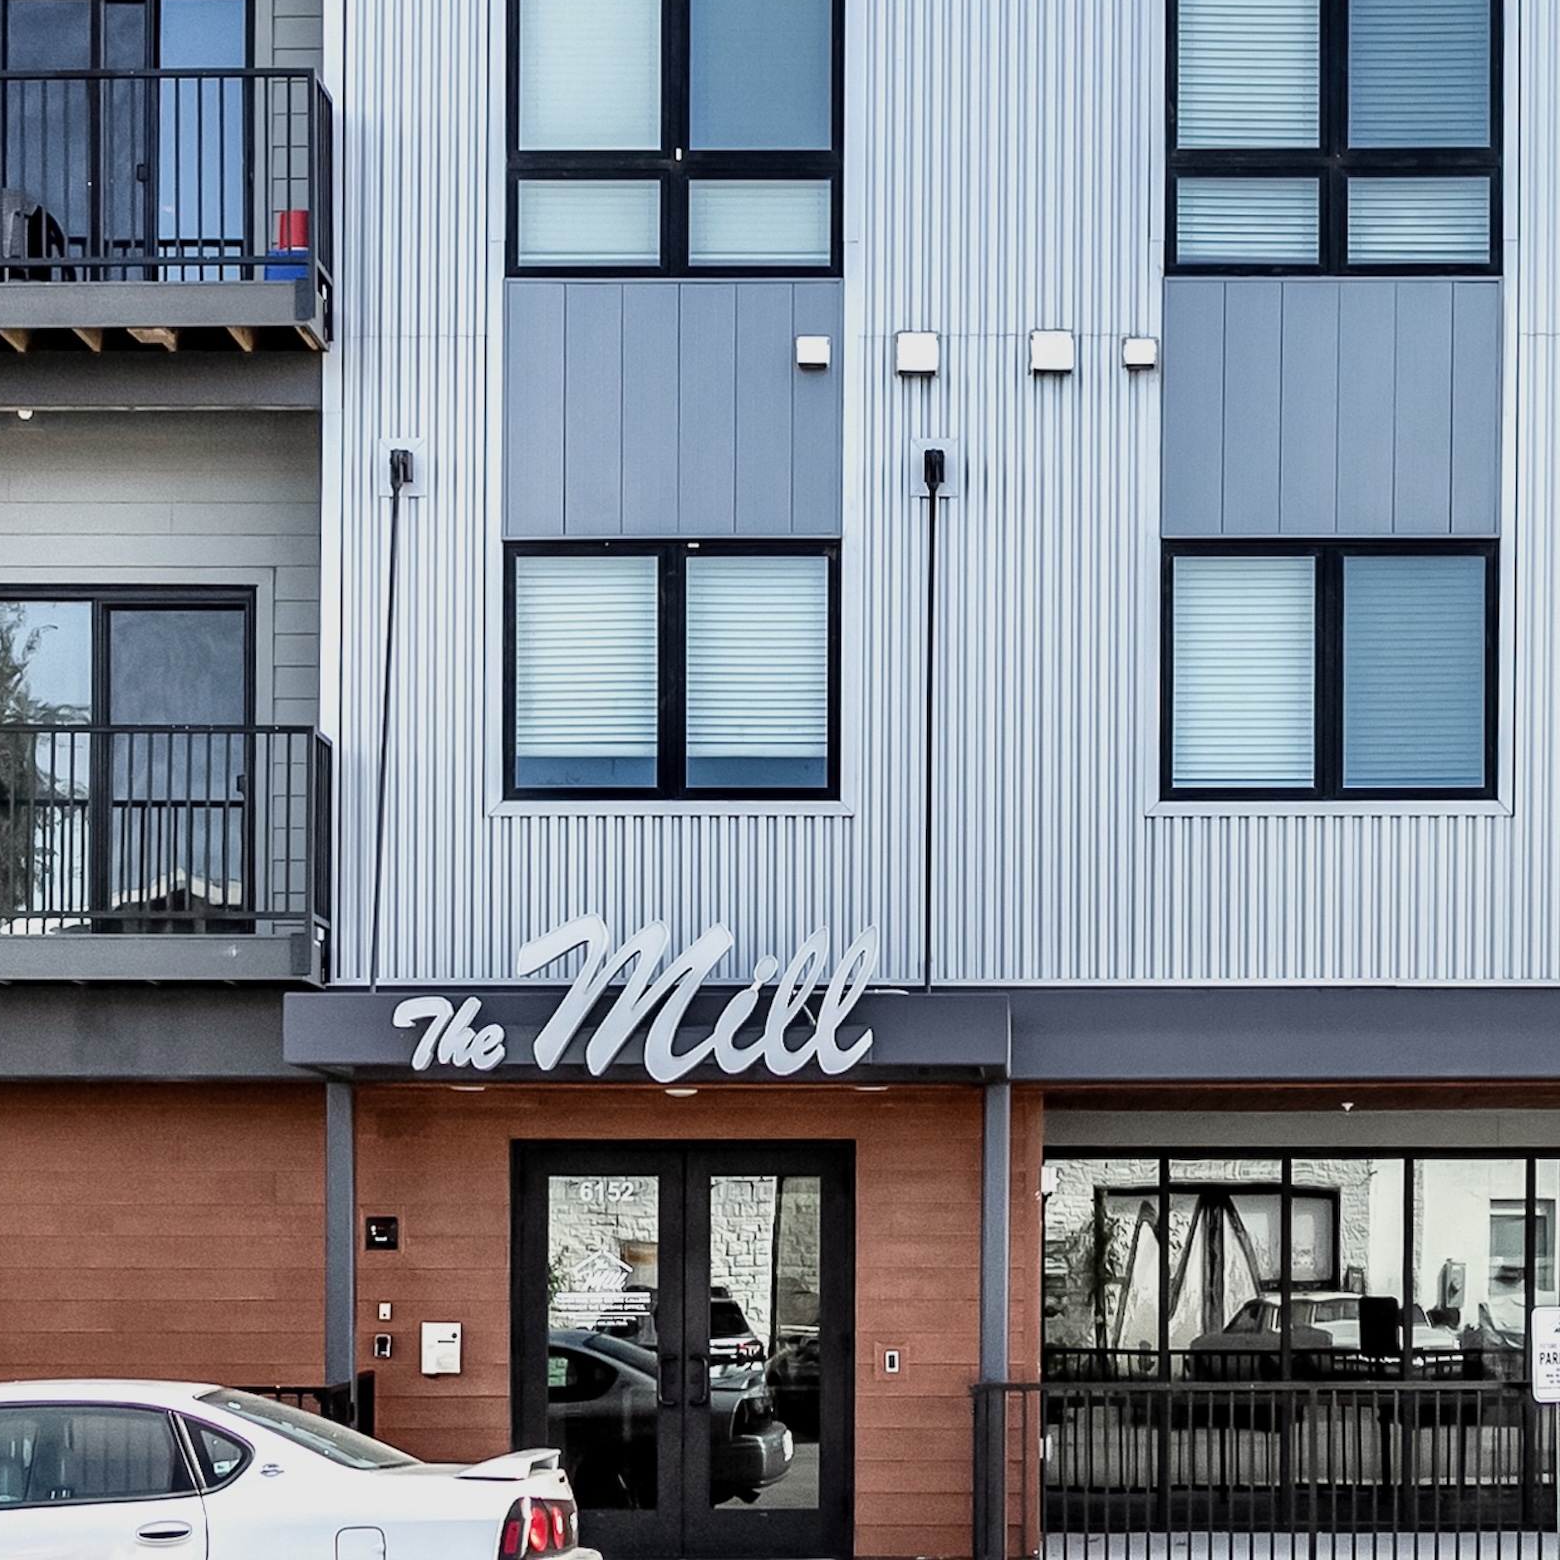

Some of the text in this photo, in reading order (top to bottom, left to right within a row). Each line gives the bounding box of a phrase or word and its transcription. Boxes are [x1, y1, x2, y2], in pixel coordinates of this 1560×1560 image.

[393, 912, 880, 1083] The Mill
[579, 1181, 635, 1203] 6152
